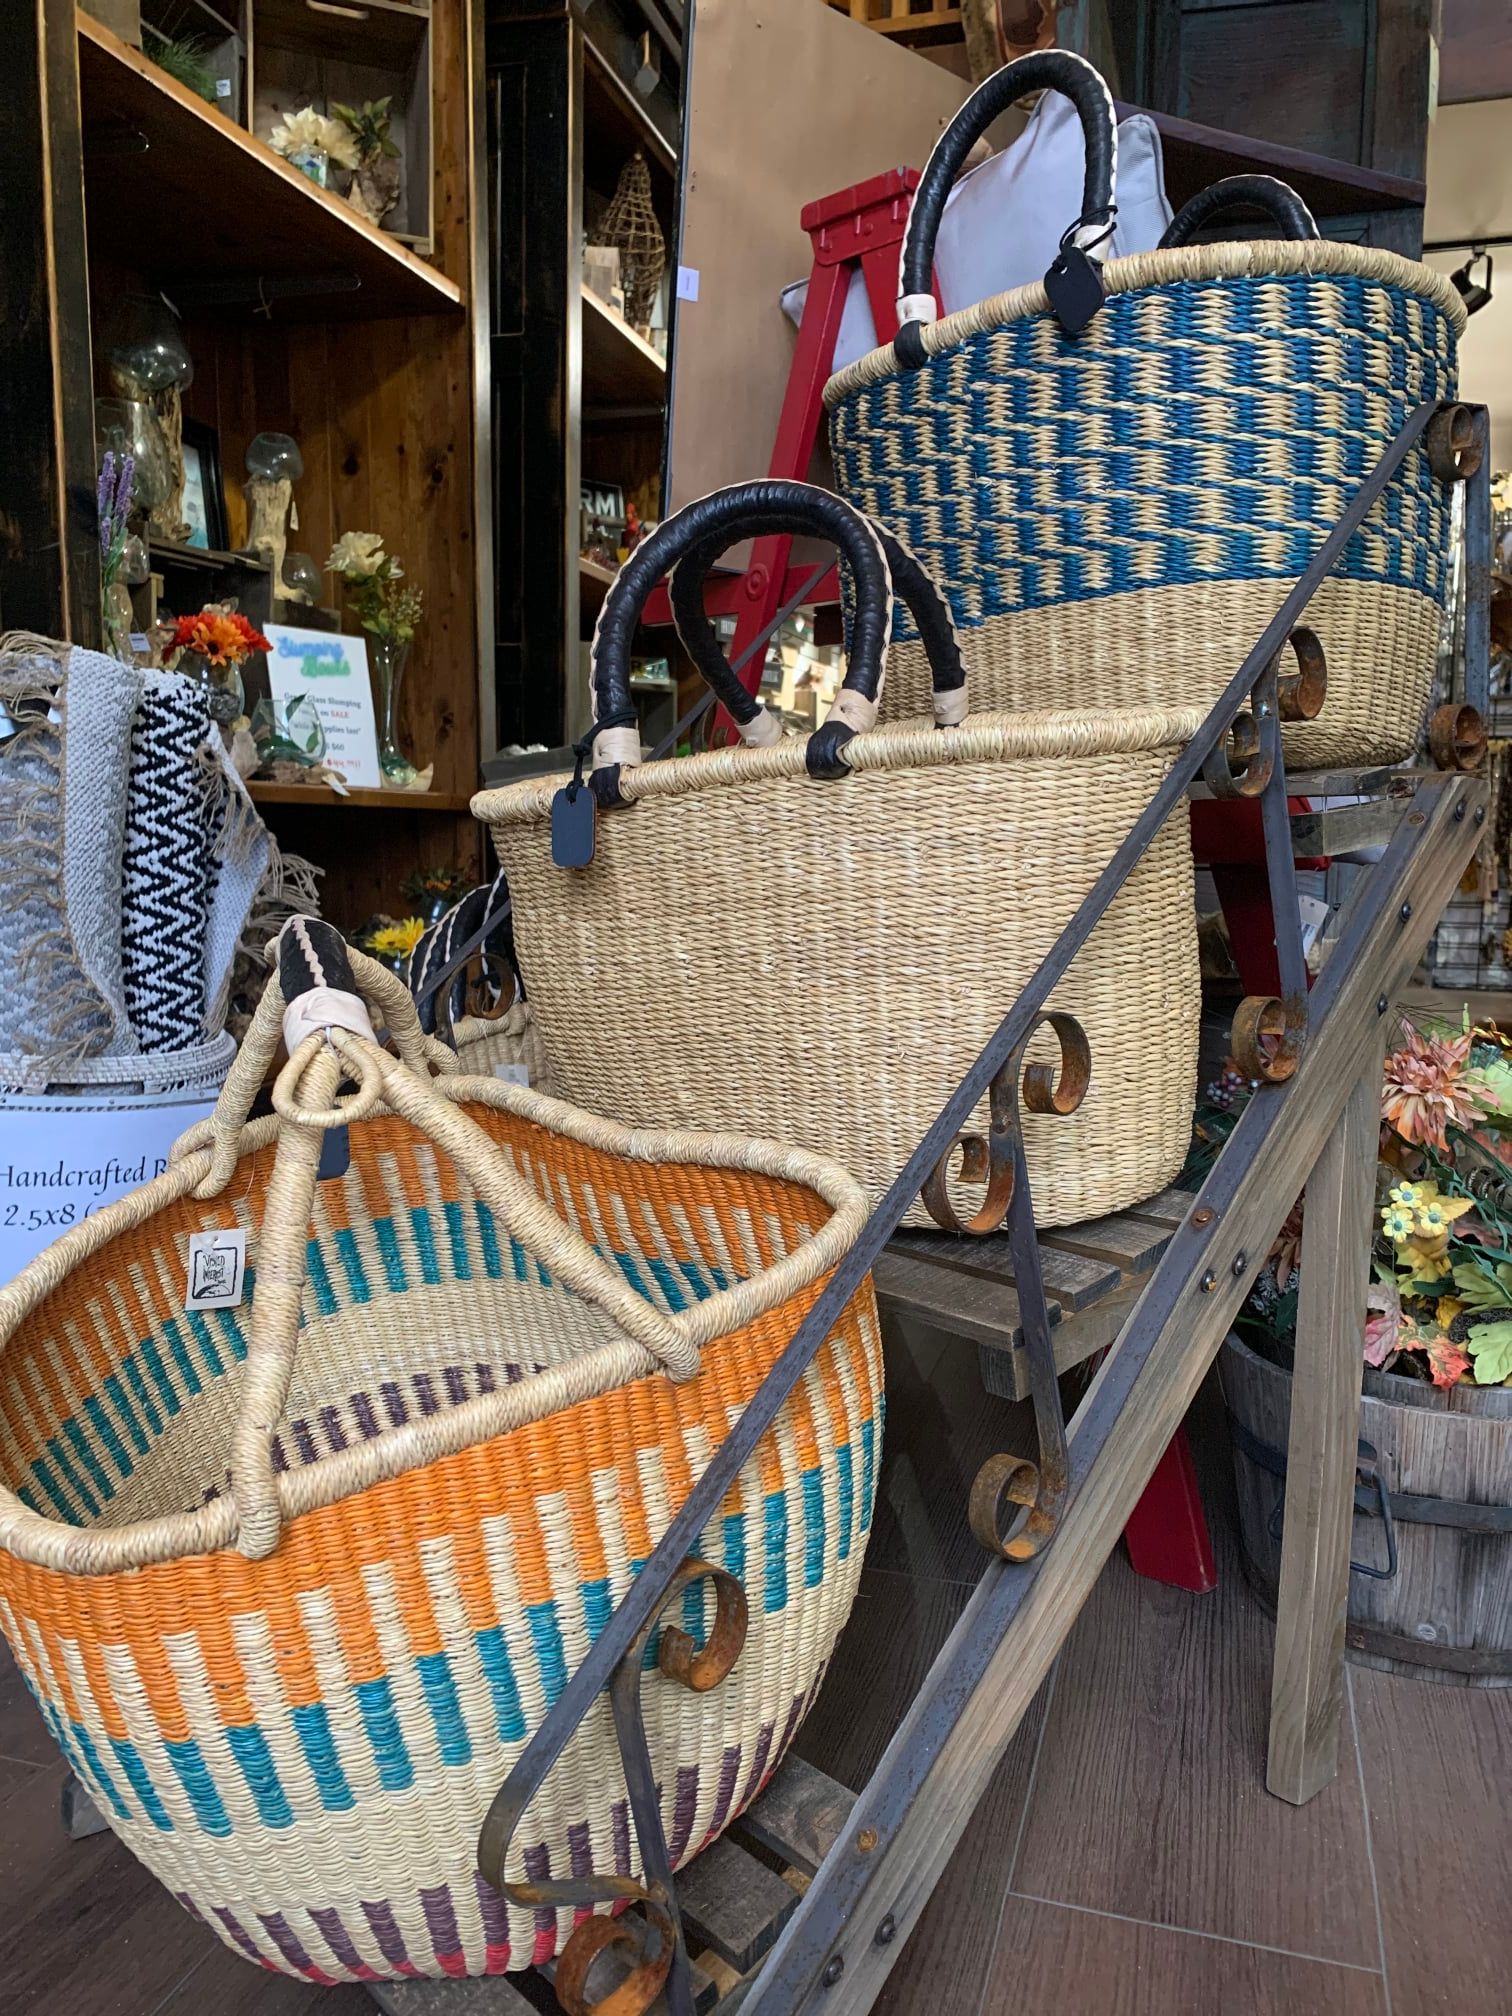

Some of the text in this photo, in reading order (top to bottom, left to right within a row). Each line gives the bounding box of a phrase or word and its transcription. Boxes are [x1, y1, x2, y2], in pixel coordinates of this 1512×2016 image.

[328, 696, 361, 709] Slumping
[0, 1156, 147, 1196] Handcrafted
[4, 1203, 75, 1231] 2.5x8
